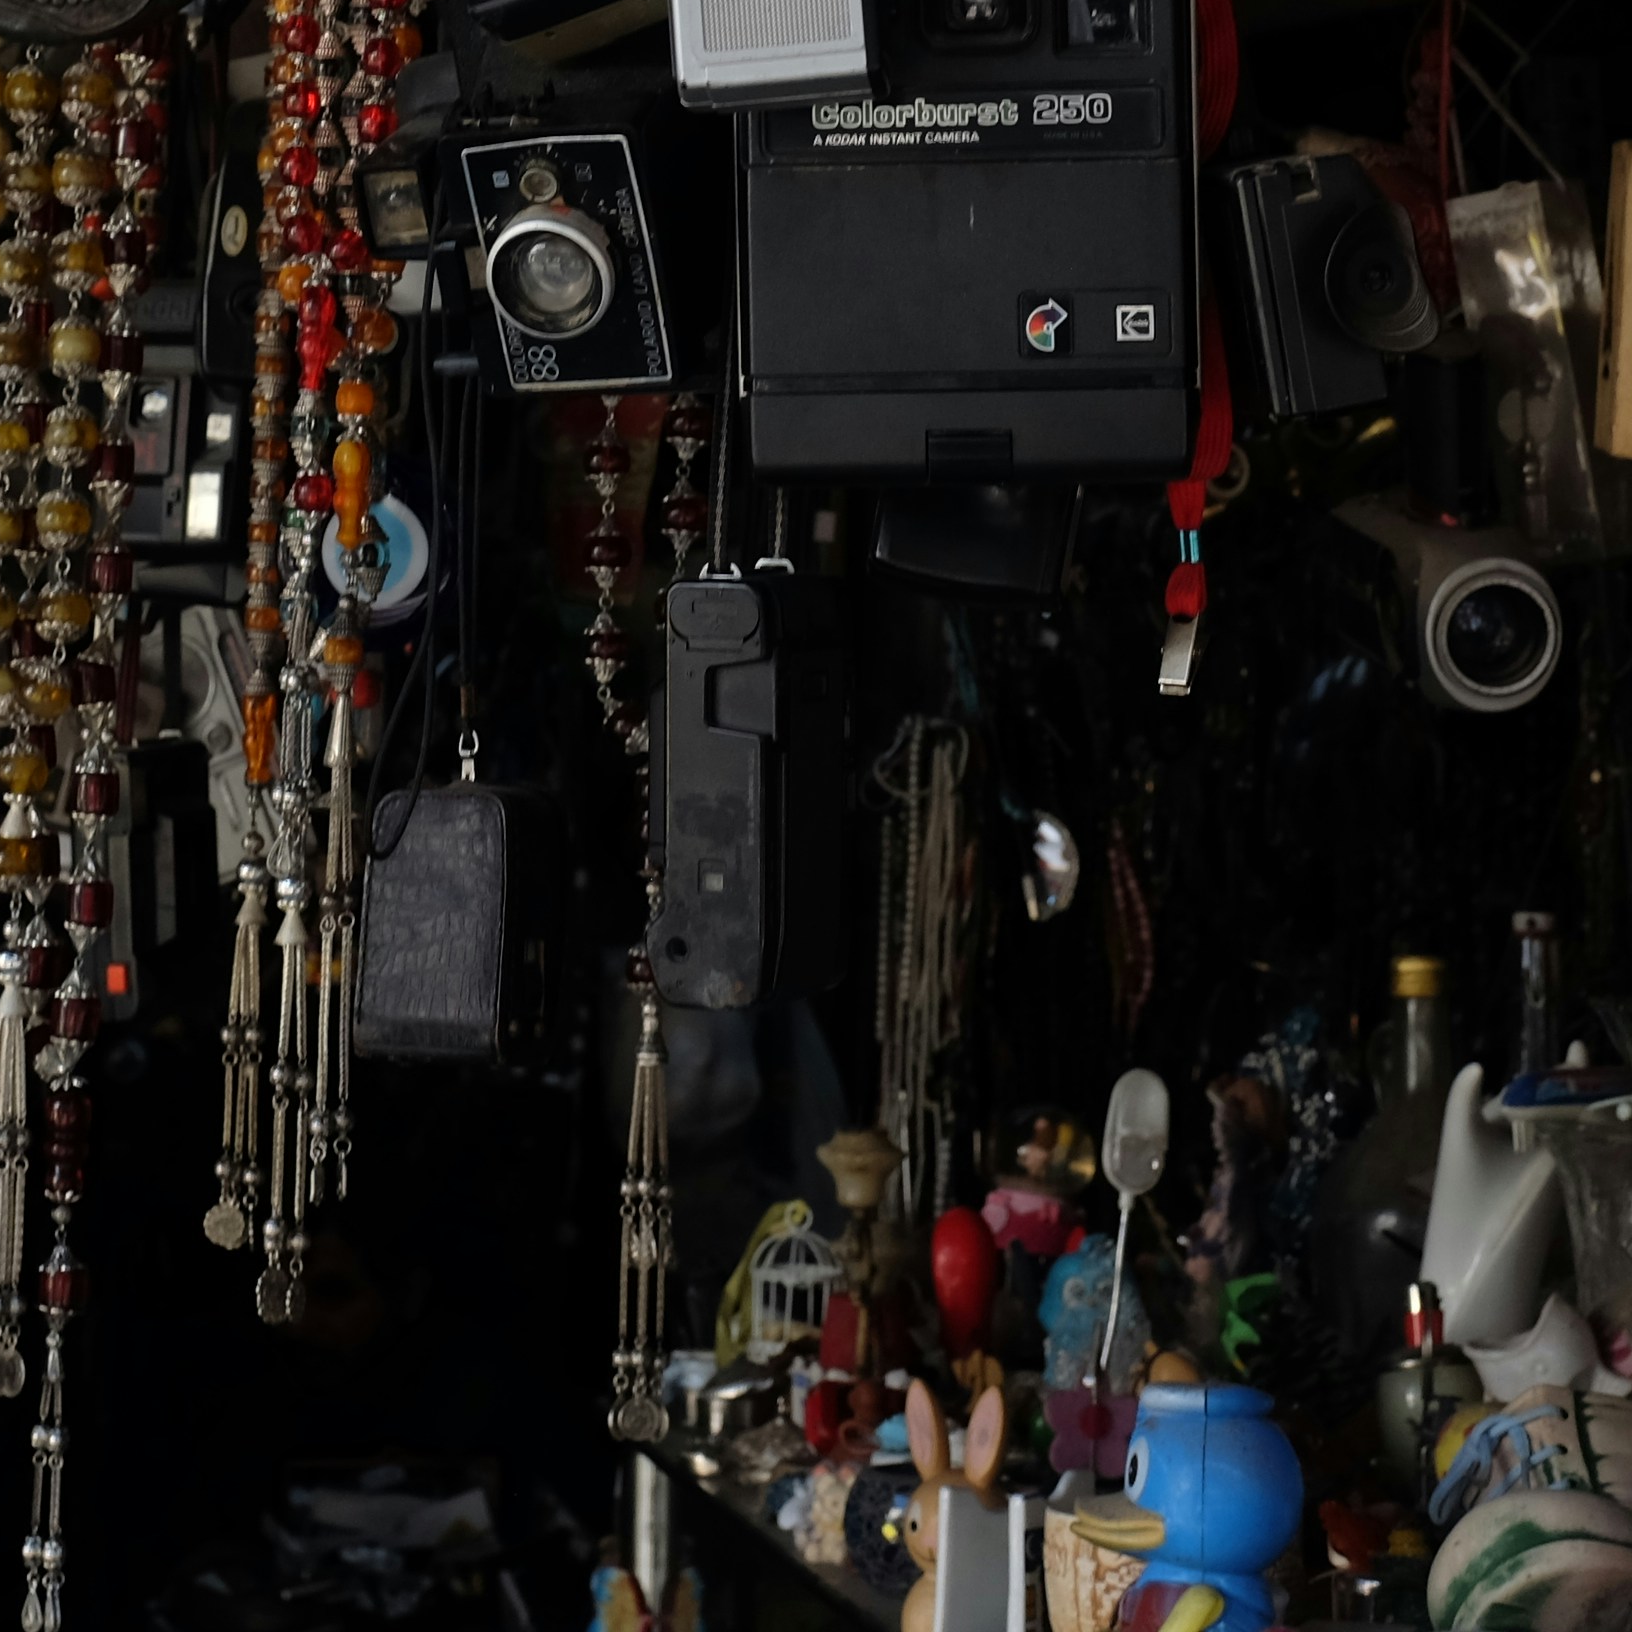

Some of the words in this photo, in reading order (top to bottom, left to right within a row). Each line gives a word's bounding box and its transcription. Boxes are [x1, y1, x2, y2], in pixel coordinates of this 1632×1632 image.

[811, 97, 1019, 130] Colorburst
[1031, 92, 1114, 126] 250
[811, 134, 824, 147] A
[824, 133, 867, 147] KODAK
[868, 132, 923, 146] INSTANT
[924, 130, 981, 144] CAMERA
[615, 187, 639, 248] CAMERA
[628, 252, 649, 295] LAND
[637, 299, 664, 377] POLAROID
[527, 343, 561, 381] 88
